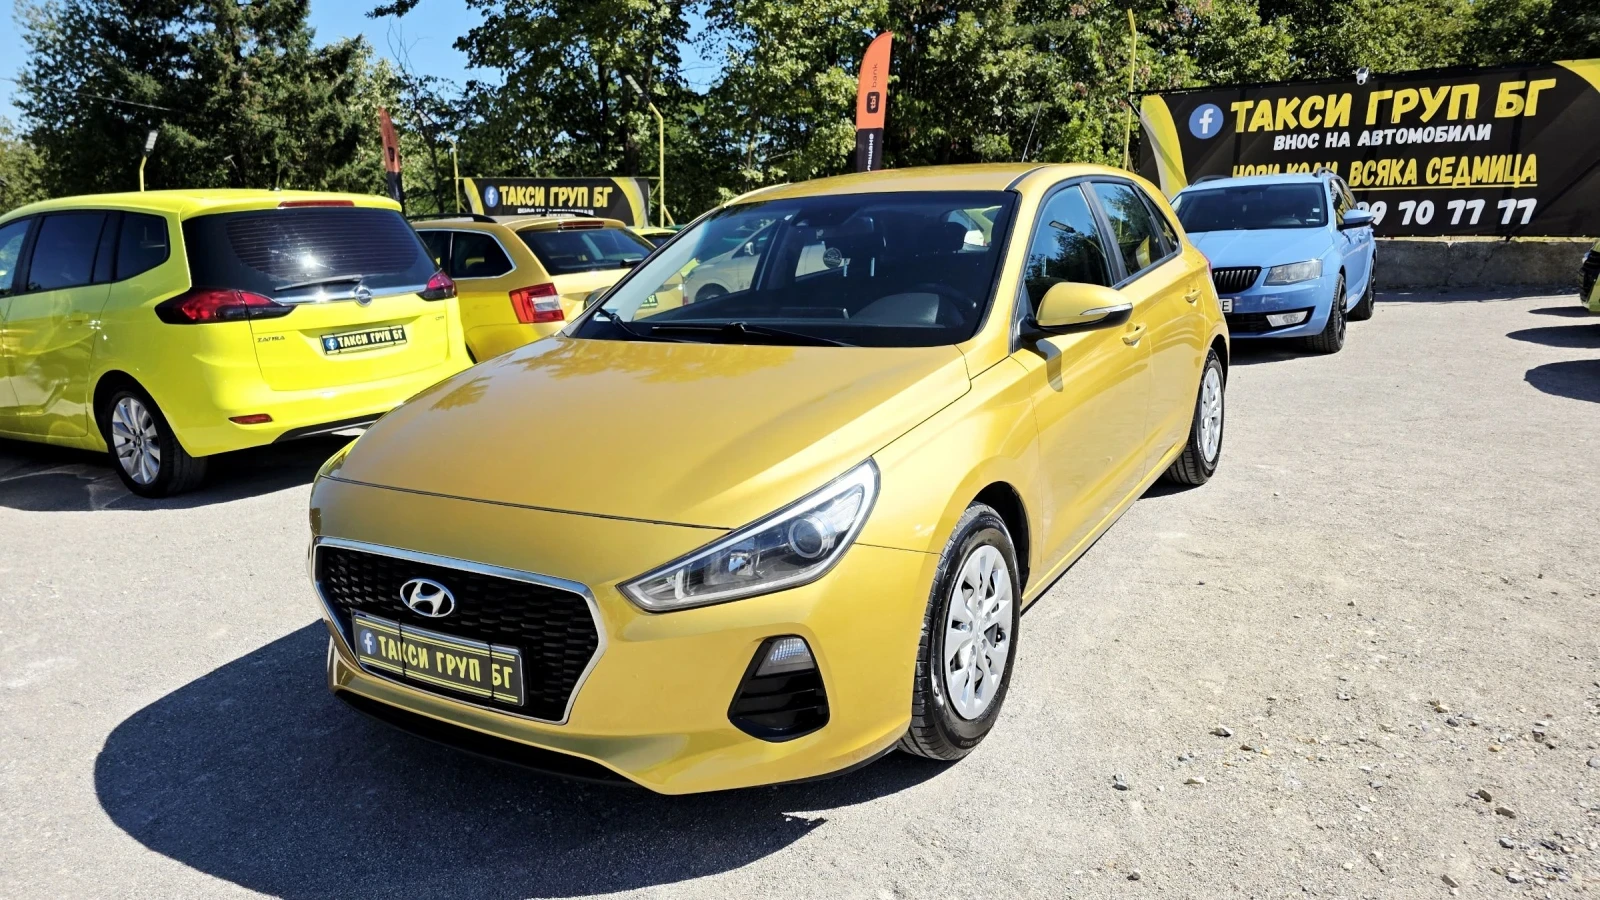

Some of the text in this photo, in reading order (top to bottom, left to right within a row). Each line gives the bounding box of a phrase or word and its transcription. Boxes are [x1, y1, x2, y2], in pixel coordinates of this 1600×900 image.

[1231, 92, 1353, 133] ТАКСИ
[1365, 83, 1480, 125] ГРУП
[1494, 78, 1557, 118] БГ
[1273, 124, 1492, 151] ВНОС НА АВТОМОБИЛИ
[1349, 158, 1417, 187] ВСЯКА
[1425, 153, 1538, 188] СЕДМИЦА
[499, 185, 545, 207] ТАКСИ
[550, 186, 588, 208] ГРУП
[593, 186, 613, 207] БГ
[1398, 199, 1435, 225] 70
[1447, 198, 1485, 225] 77
[1497, 197, 1537, 225] 77
[337, 333, 368, 348] ТАКСИ
[370, 330, 392, 343] ГРУП
[392, 329, 403, 339] БГ
[378, 635, 429, 669] ТАКСИ
[435, 651, 481, 682] ГРУП
[491, 663, 513, 689] БГ
